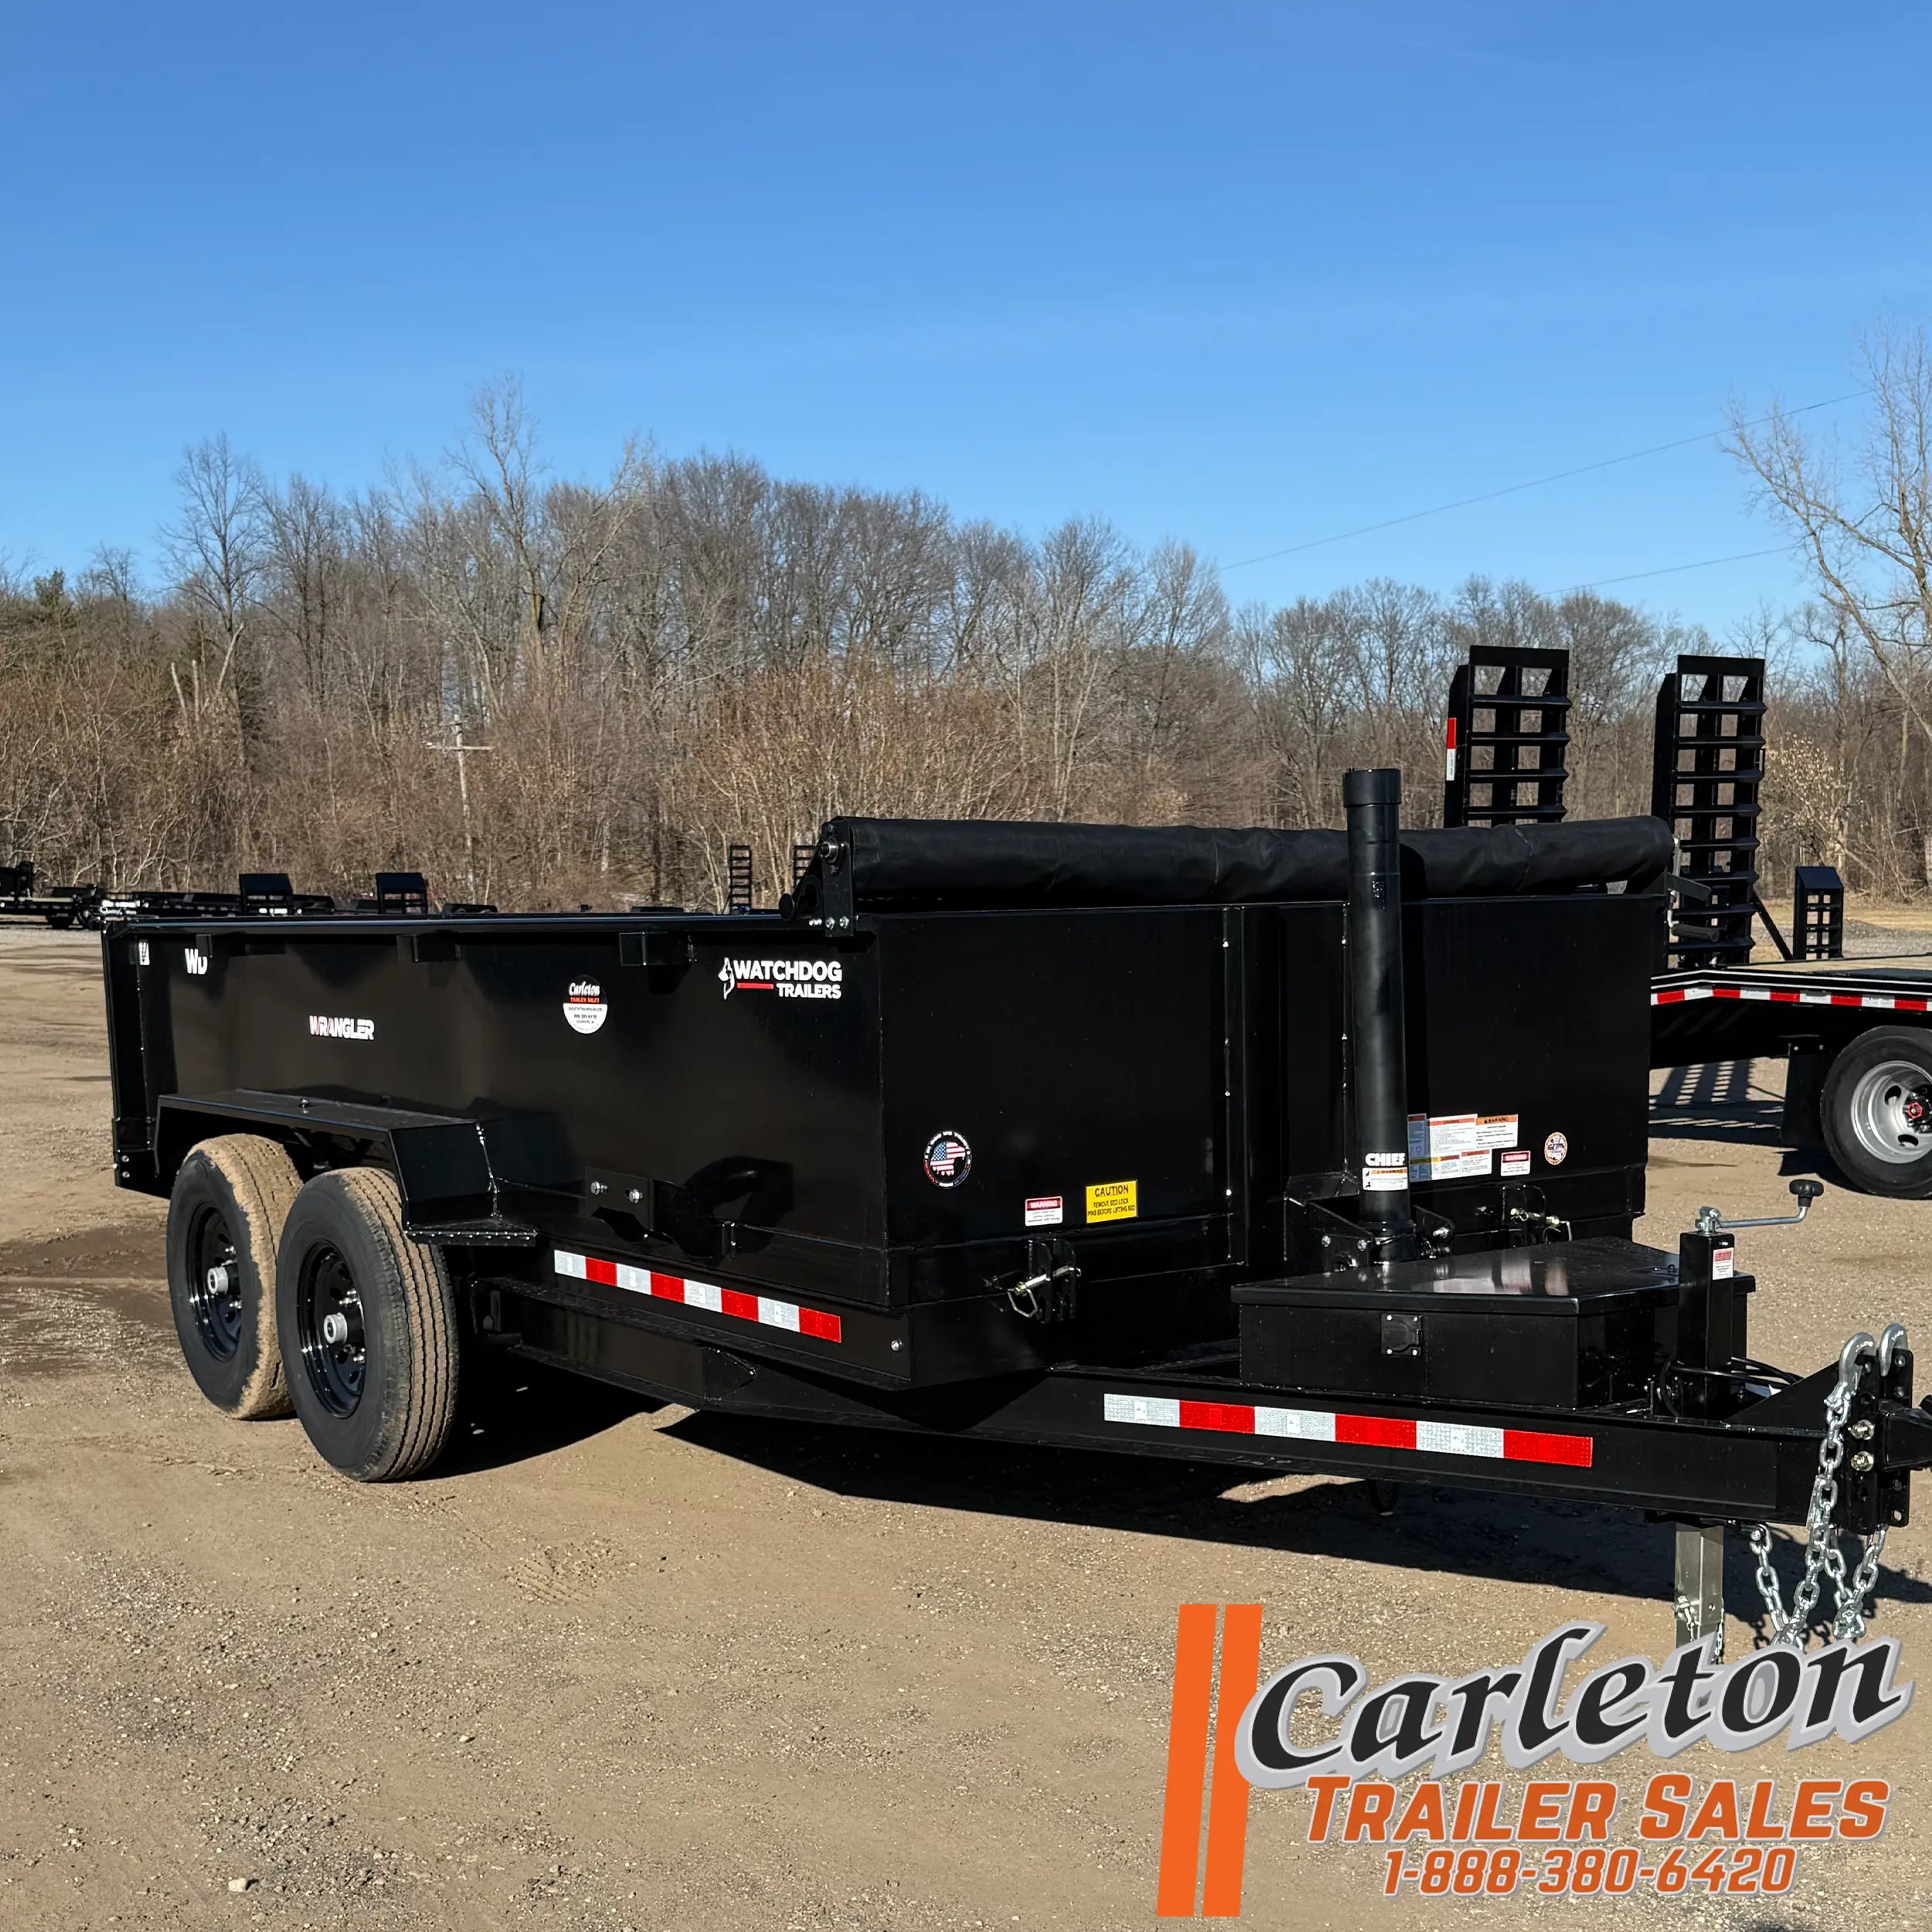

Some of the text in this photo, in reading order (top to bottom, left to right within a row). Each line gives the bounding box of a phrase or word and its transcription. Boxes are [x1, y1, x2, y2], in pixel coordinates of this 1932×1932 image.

[733, 960, 842, 981] WATCHDOG
[776, 983, 842, 999] TRAILERS
[309, 1015, 375, 1040] WRANGLER
[1365, 1152, 1406, 1166] CHIEF
[1094, 1184, 1129, 1197] CAUTION
